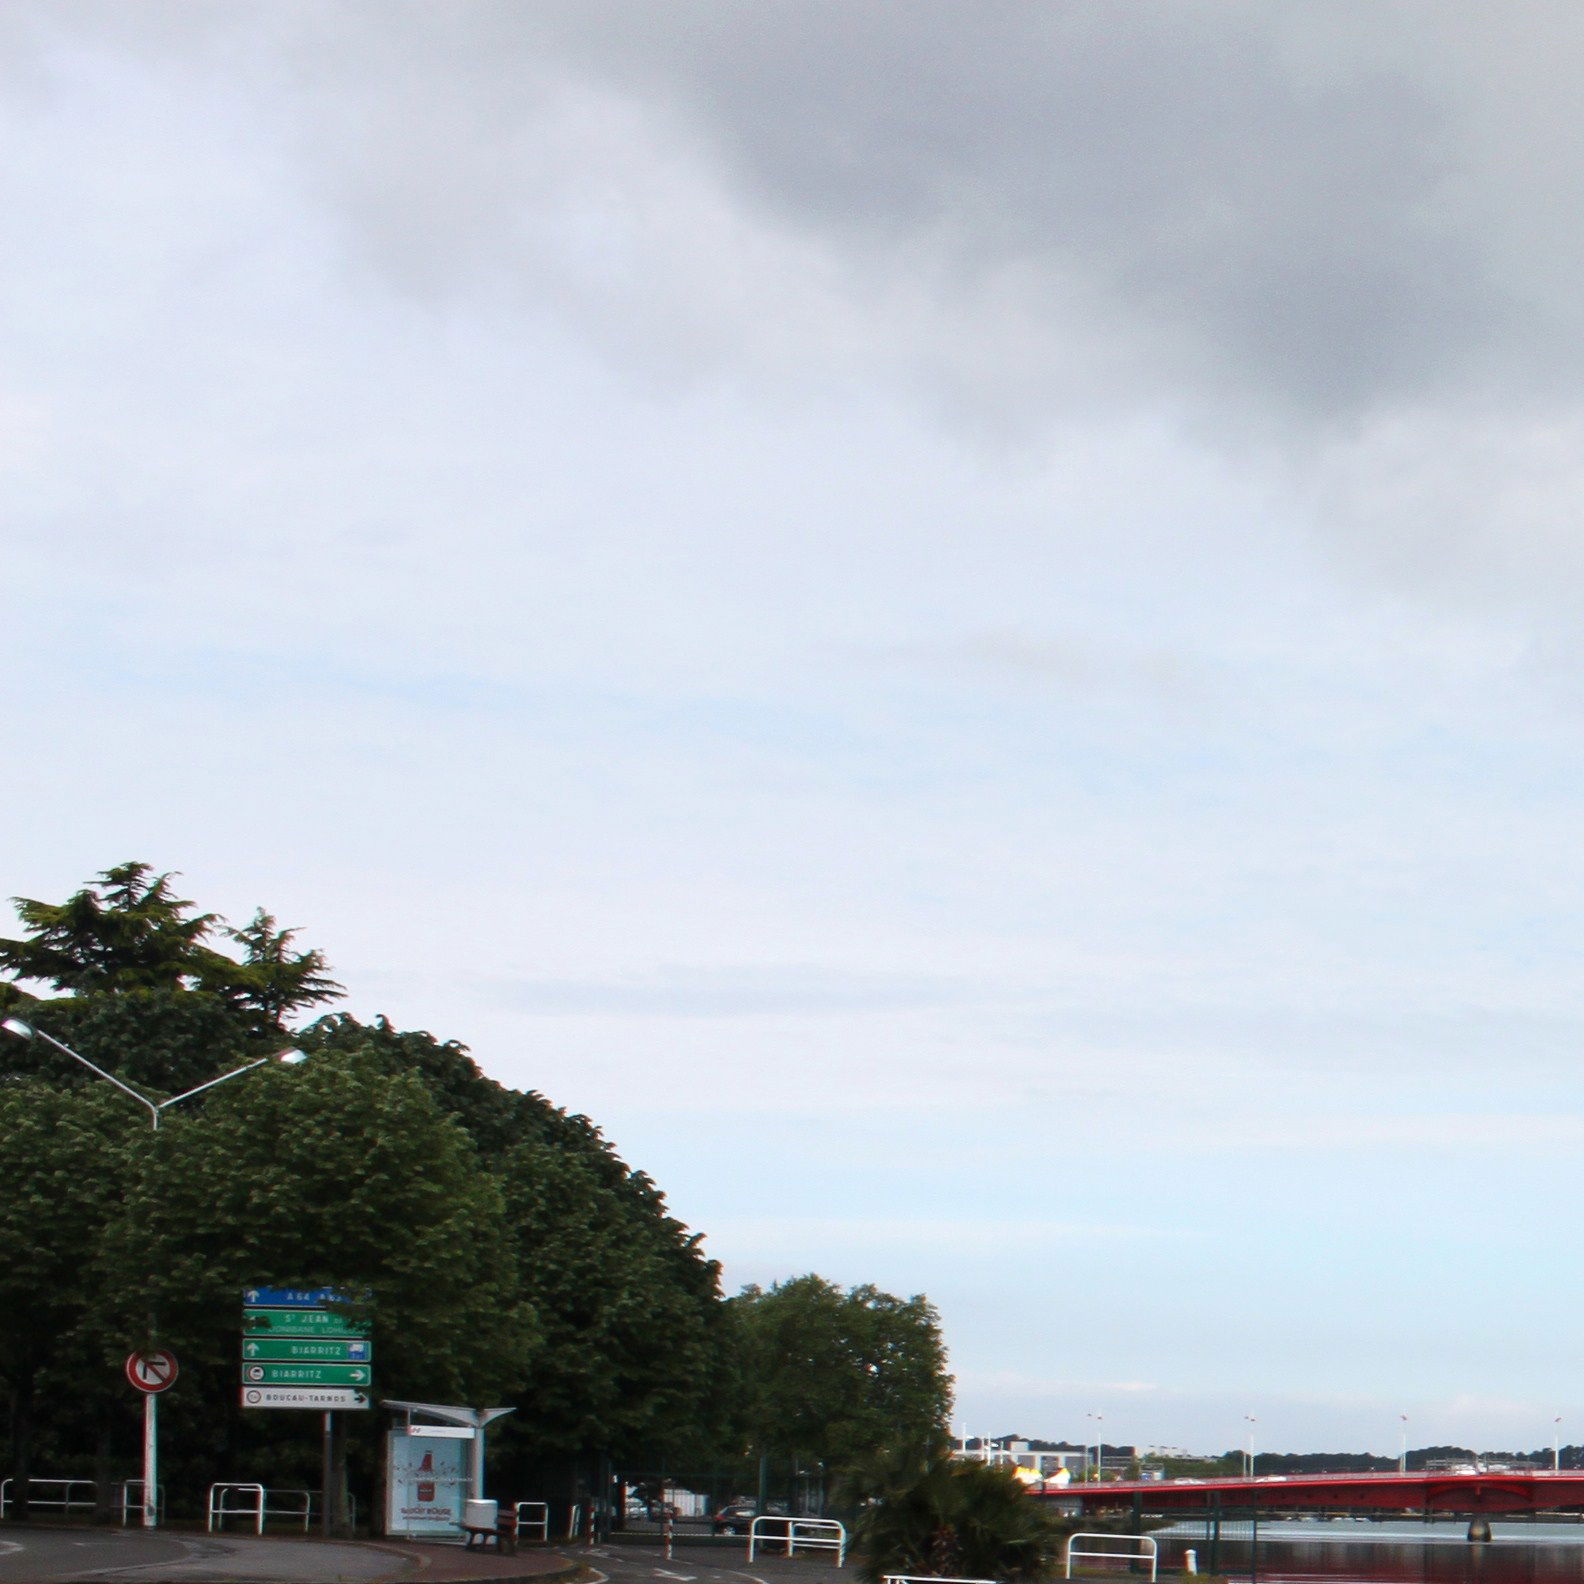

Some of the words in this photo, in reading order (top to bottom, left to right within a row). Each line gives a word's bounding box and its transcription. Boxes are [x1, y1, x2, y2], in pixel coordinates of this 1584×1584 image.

[302, 1314, 329, 1323] JEAN
[291, 1345, 341, 1356] BIARRITZ
[271, 1369, 322, 1379] BIARRITZ
[266, 1394, 346, 1403] BOUCAU-TARNOS
